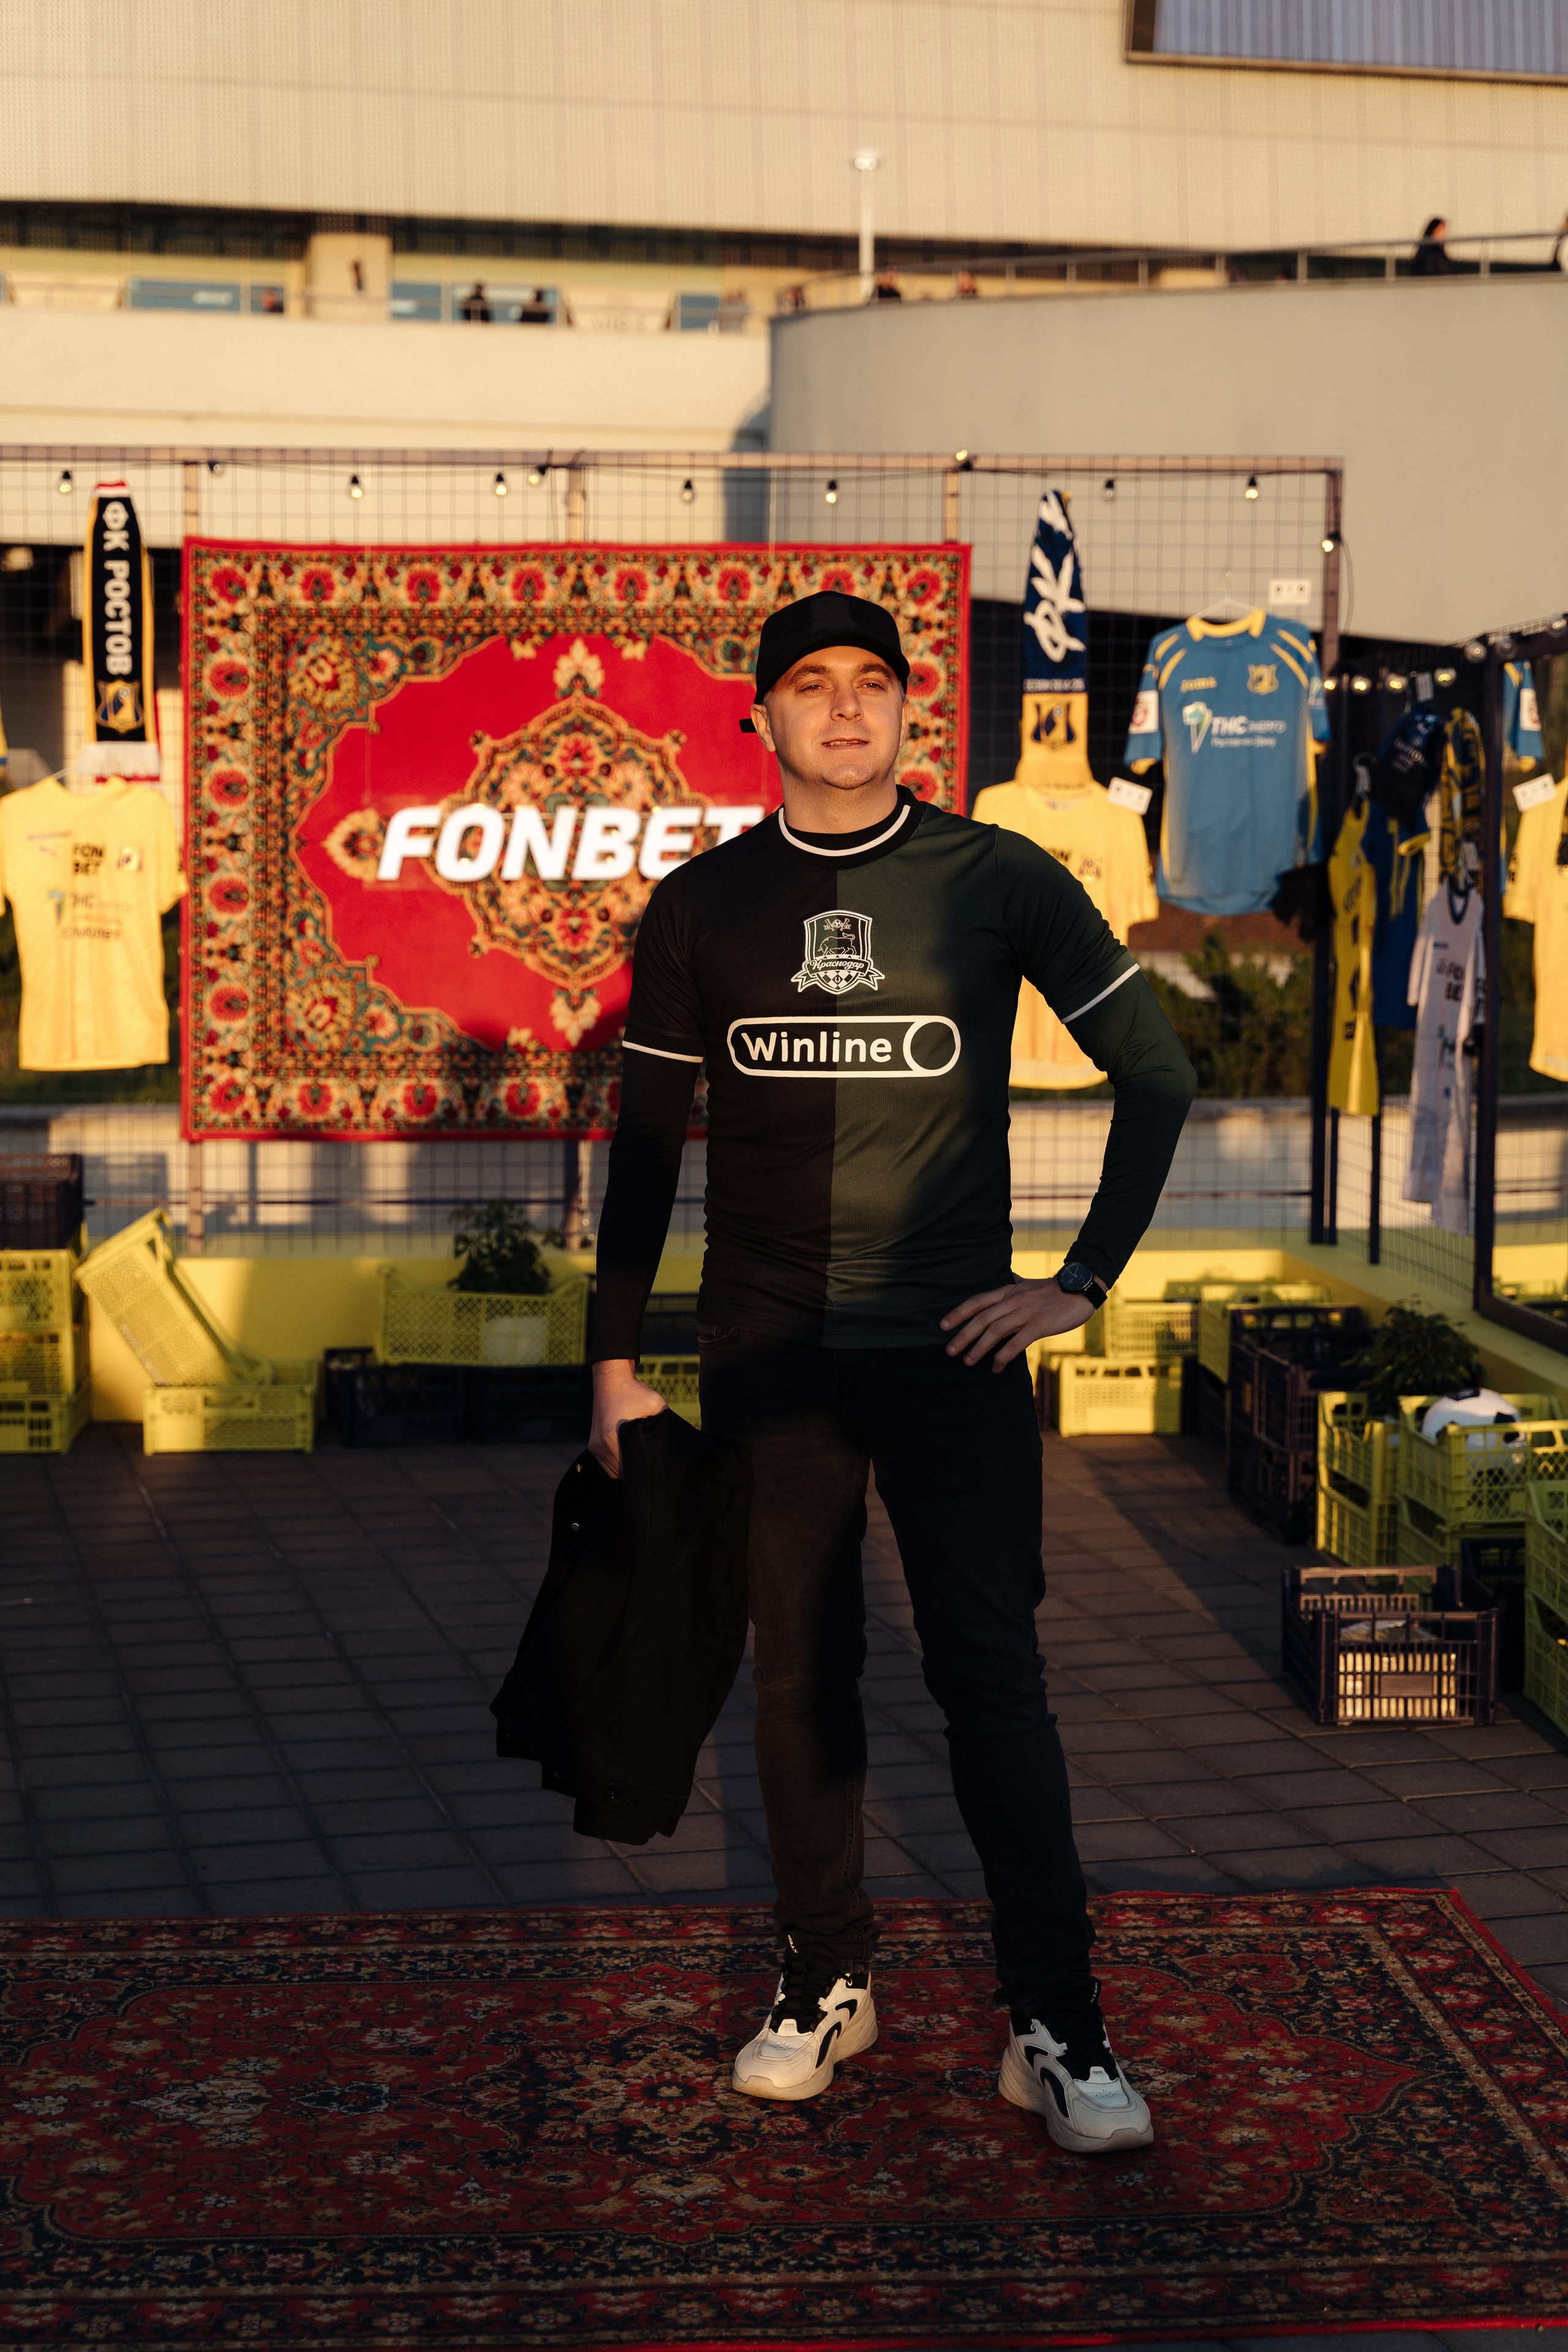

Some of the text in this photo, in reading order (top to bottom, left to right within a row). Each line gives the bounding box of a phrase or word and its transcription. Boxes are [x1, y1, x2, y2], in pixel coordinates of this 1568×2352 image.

[102, 501, 132, 674] ФК РОСТОВ
[376, 805, 765, 882] FONBET
[810, 959, 864, 971] Краснодар
[741, 1031, 892, 1063] Winline
